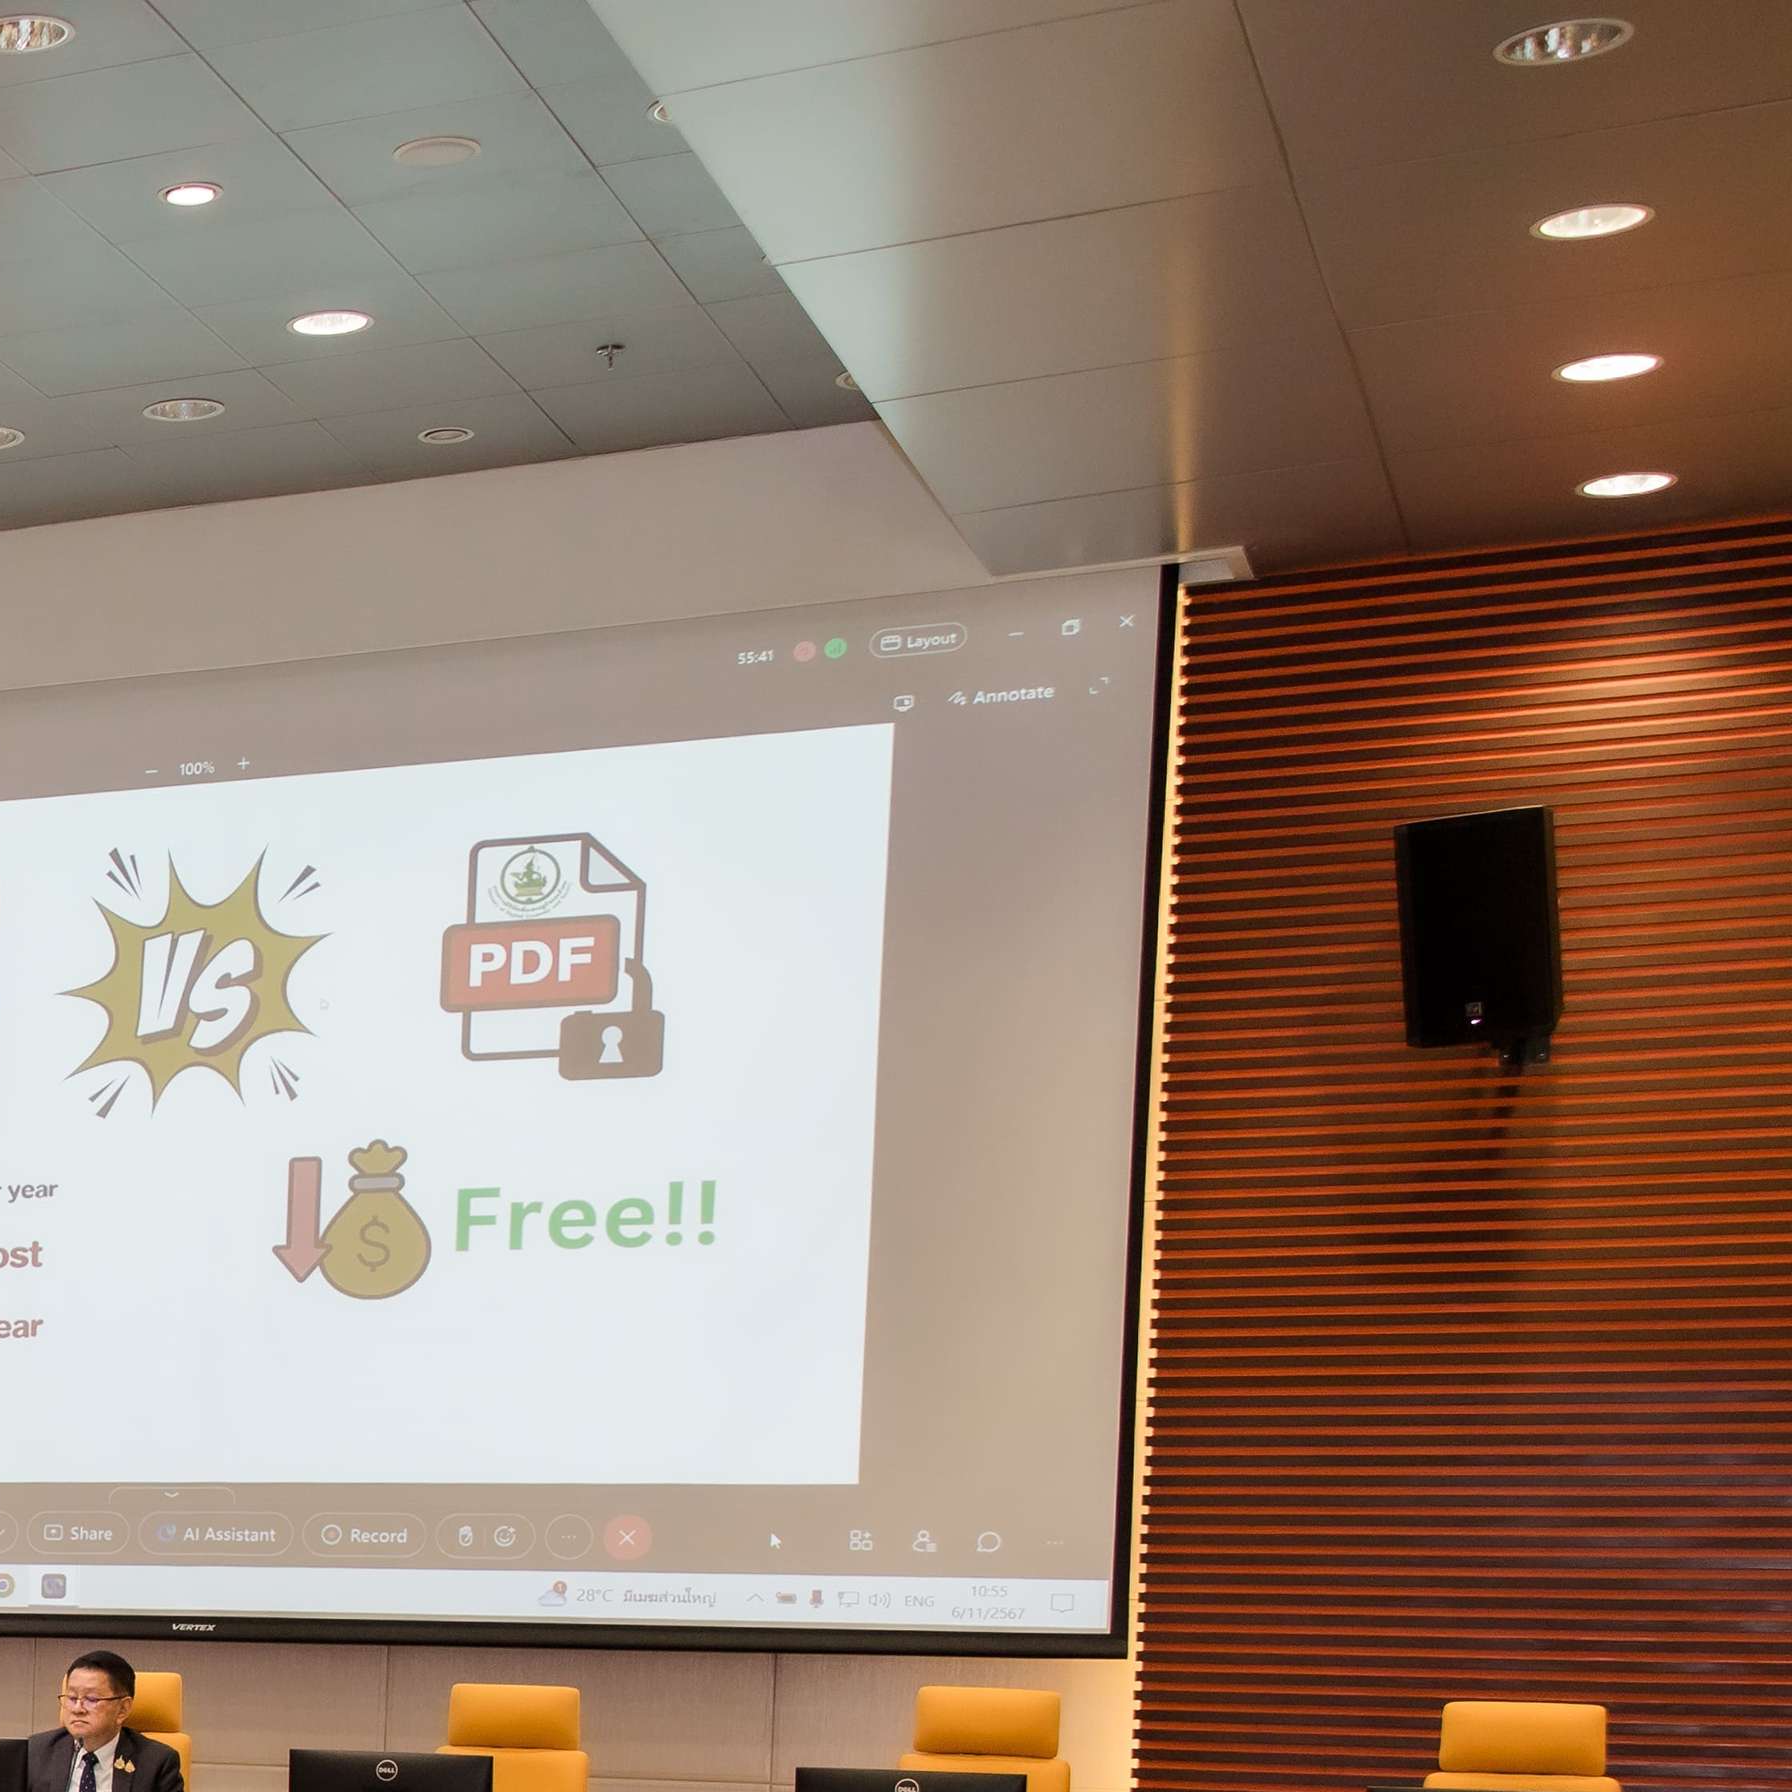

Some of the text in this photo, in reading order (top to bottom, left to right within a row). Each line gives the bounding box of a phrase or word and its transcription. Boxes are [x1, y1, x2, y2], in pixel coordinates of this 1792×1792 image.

[906, 632, 958, 652] Layout
[737, 648, 775, 665] 55:41
[973, 684, 1055, 705] Annotate
[179, 761, 215, 776] 100%
[468, 936, 596, 988] PDF
[135, 926, 259, 1052] VS
[7, 1183, 59, 1203] year
[455, 1180, 717, 1252] Free!!
[70, 1526, 113, 1541] Share
[183, 1527, 276, 1542] AI Assistant
[350, 1528, 408, 1543] Record
[576, 1588, 614, 1603] 28°C
[971, 1585, 1008, 1598] 10:55
[904, 1595, 935, 1608] ENG
[951, 1607, 1025, 1620] 6/11/2567
[172, 1623, 216, 1631] VERTEX
